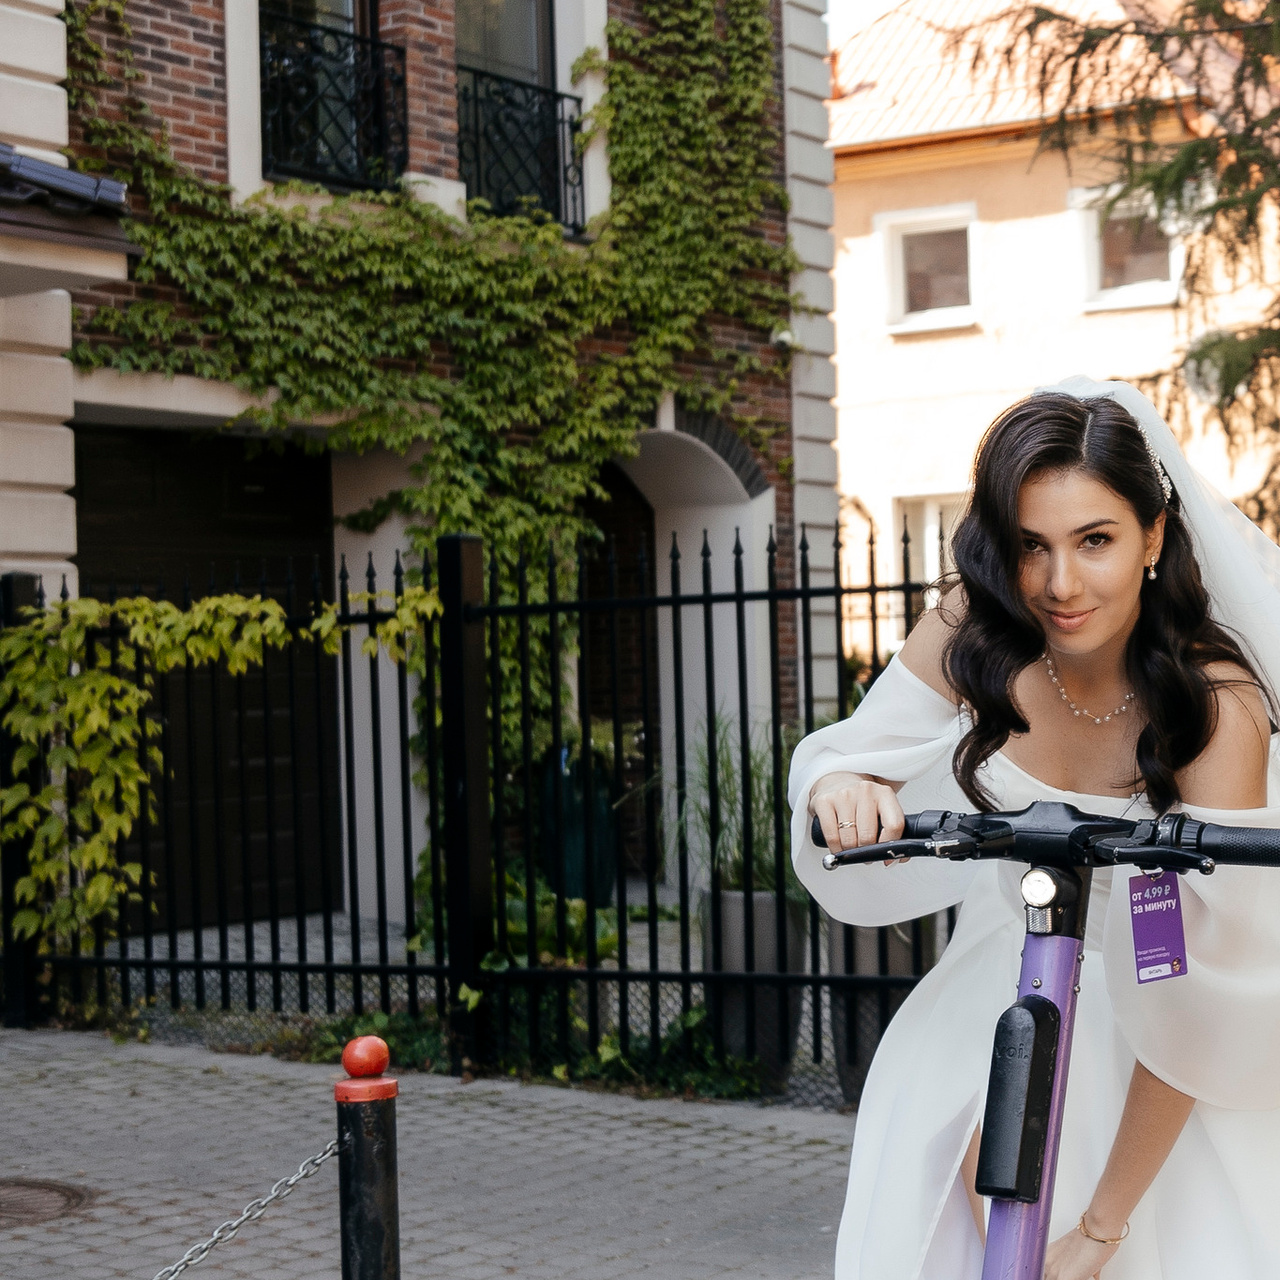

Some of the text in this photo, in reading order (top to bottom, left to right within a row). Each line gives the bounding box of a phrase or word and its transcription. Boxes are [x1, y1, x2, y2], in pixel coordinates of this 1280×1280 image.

[1131, 892, 1142, 901] от
[1144, 888, 1163, 899] 4,99
[1132, 899, 1177, 915] за минуту
